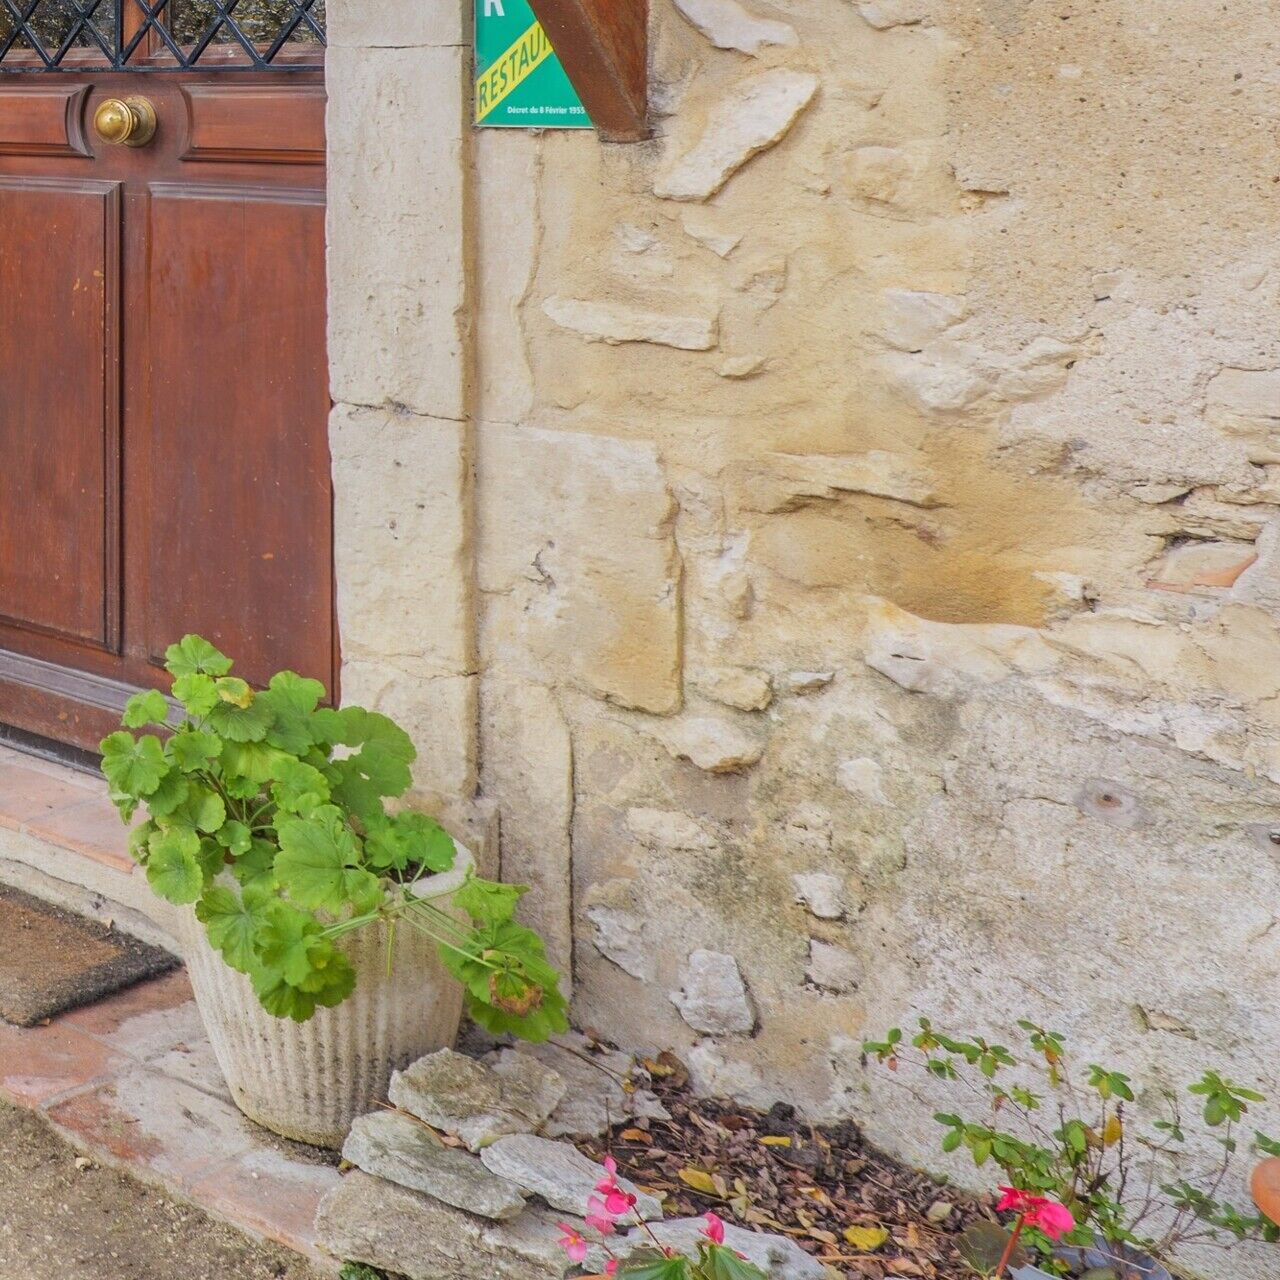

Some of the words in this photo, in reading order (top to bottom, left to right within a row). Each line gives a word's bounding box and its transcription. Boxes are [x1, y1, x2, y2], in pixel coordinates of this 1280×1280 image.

[507, 106, 529, 114] Décret
[530, 106, 539, 114] du
[539, 106, 544, 114] 8
[545, 106, 568, 114] Février
